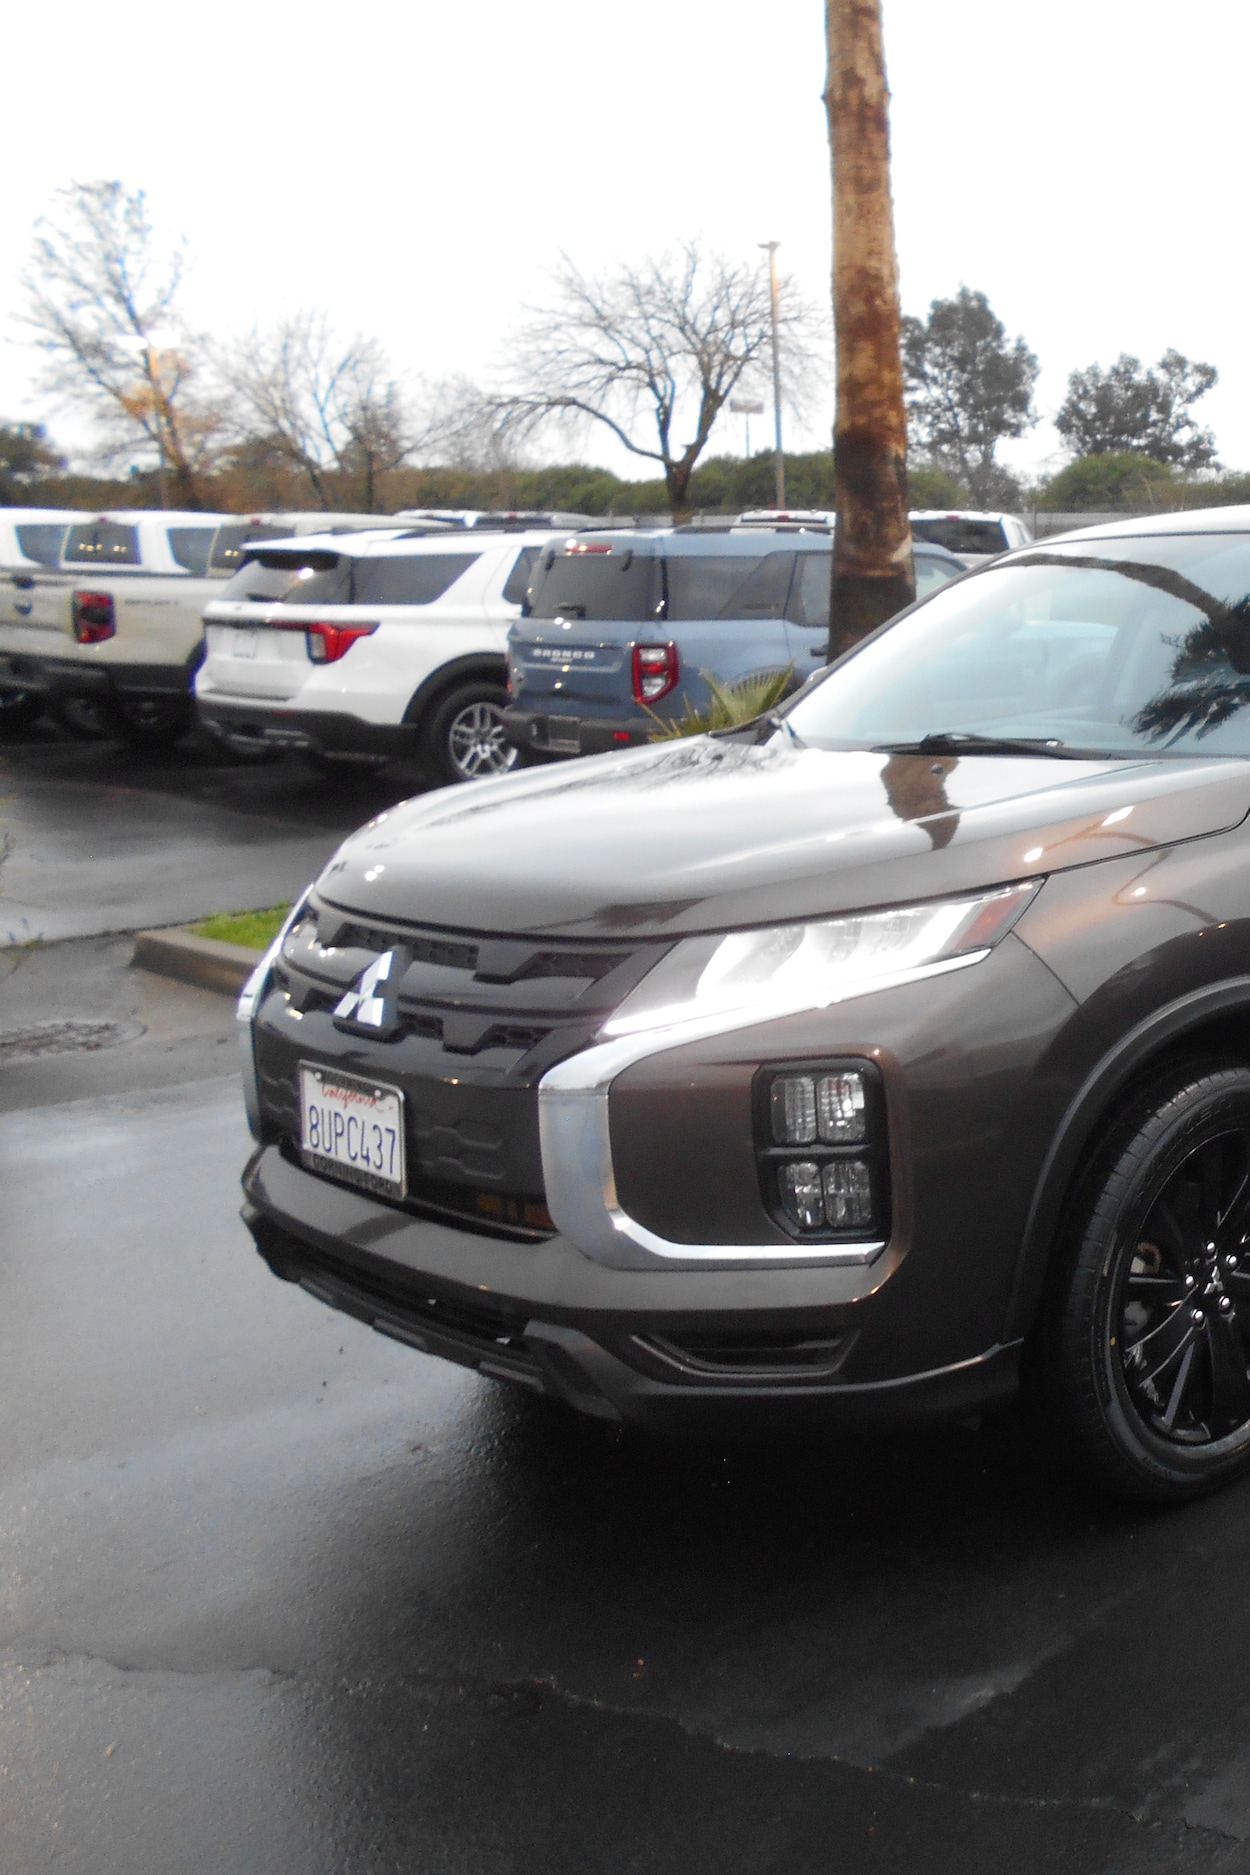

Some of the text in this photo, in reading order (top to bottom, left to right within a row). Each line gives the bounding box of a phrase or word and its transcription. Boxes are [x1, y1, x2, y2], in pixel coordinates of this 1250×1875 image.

[532, 648, 595, 660] BRONCO
[321, 1084, 381, 1110] California
[308, 1104, 396, 1175] 8UPC437
